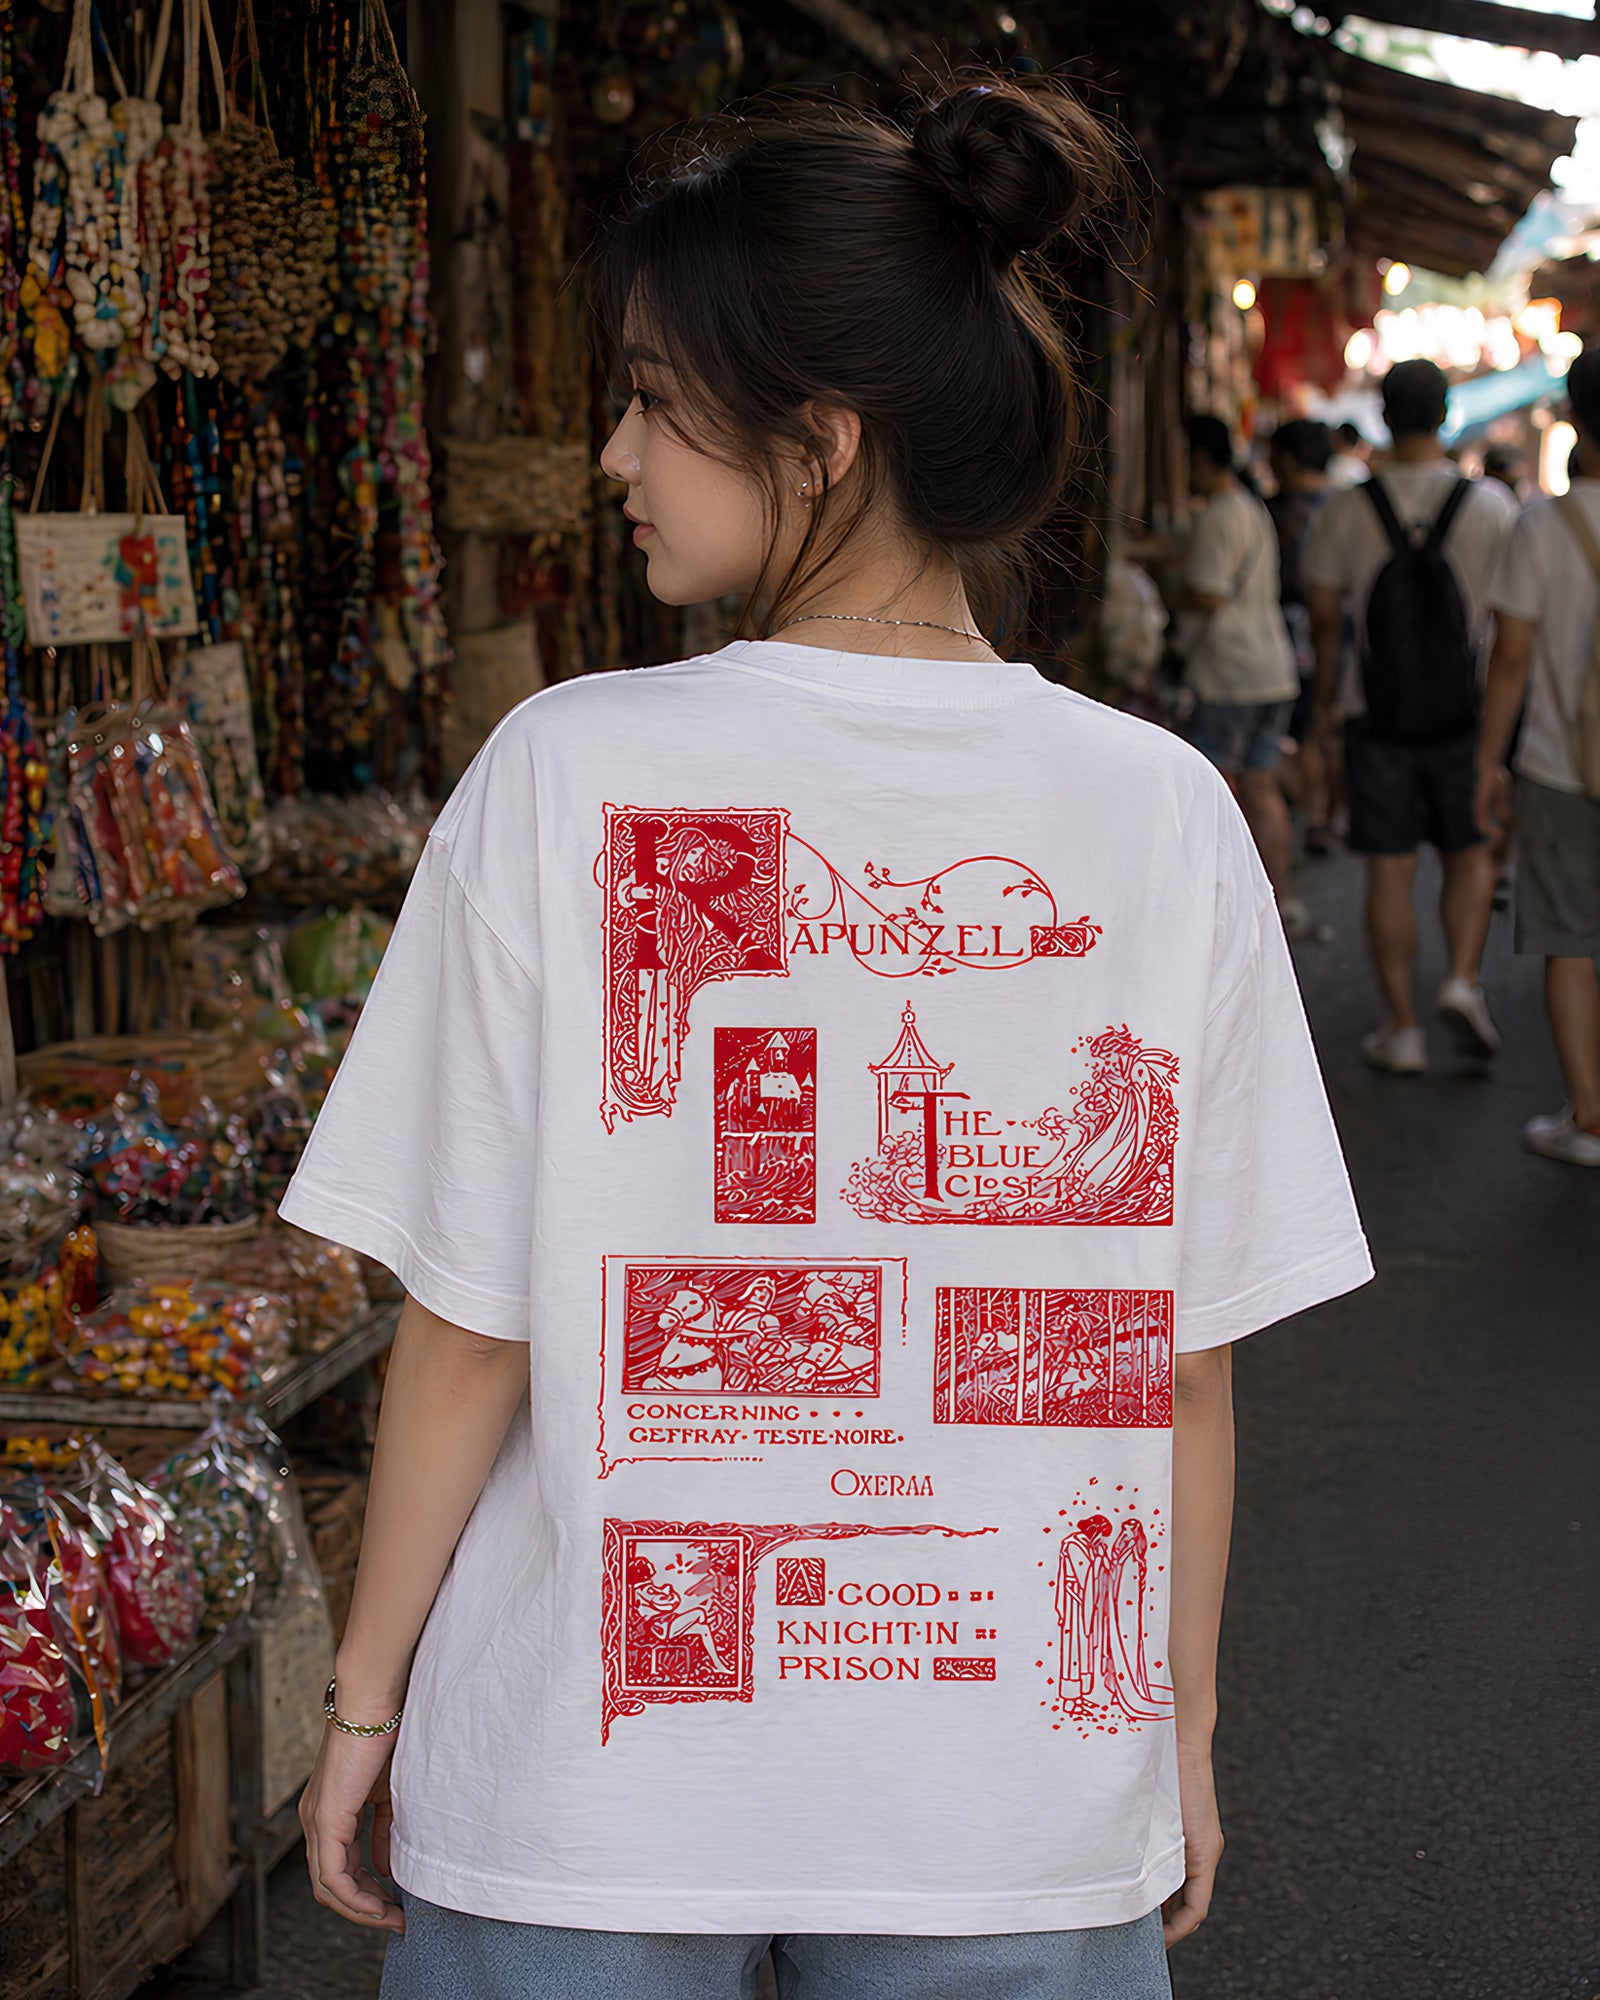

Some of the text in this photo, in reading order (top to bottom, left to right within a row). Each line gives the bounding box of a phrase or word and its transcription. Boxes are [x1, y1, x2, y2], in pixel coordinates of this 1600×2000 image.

[888, 1091, 1002, 1202] THE
[947, 1145, 1046, 1168] BLUE
[626, 1403, 800, 1421] CONCERNING
[778, 1656, 920, 1681] PRISON
